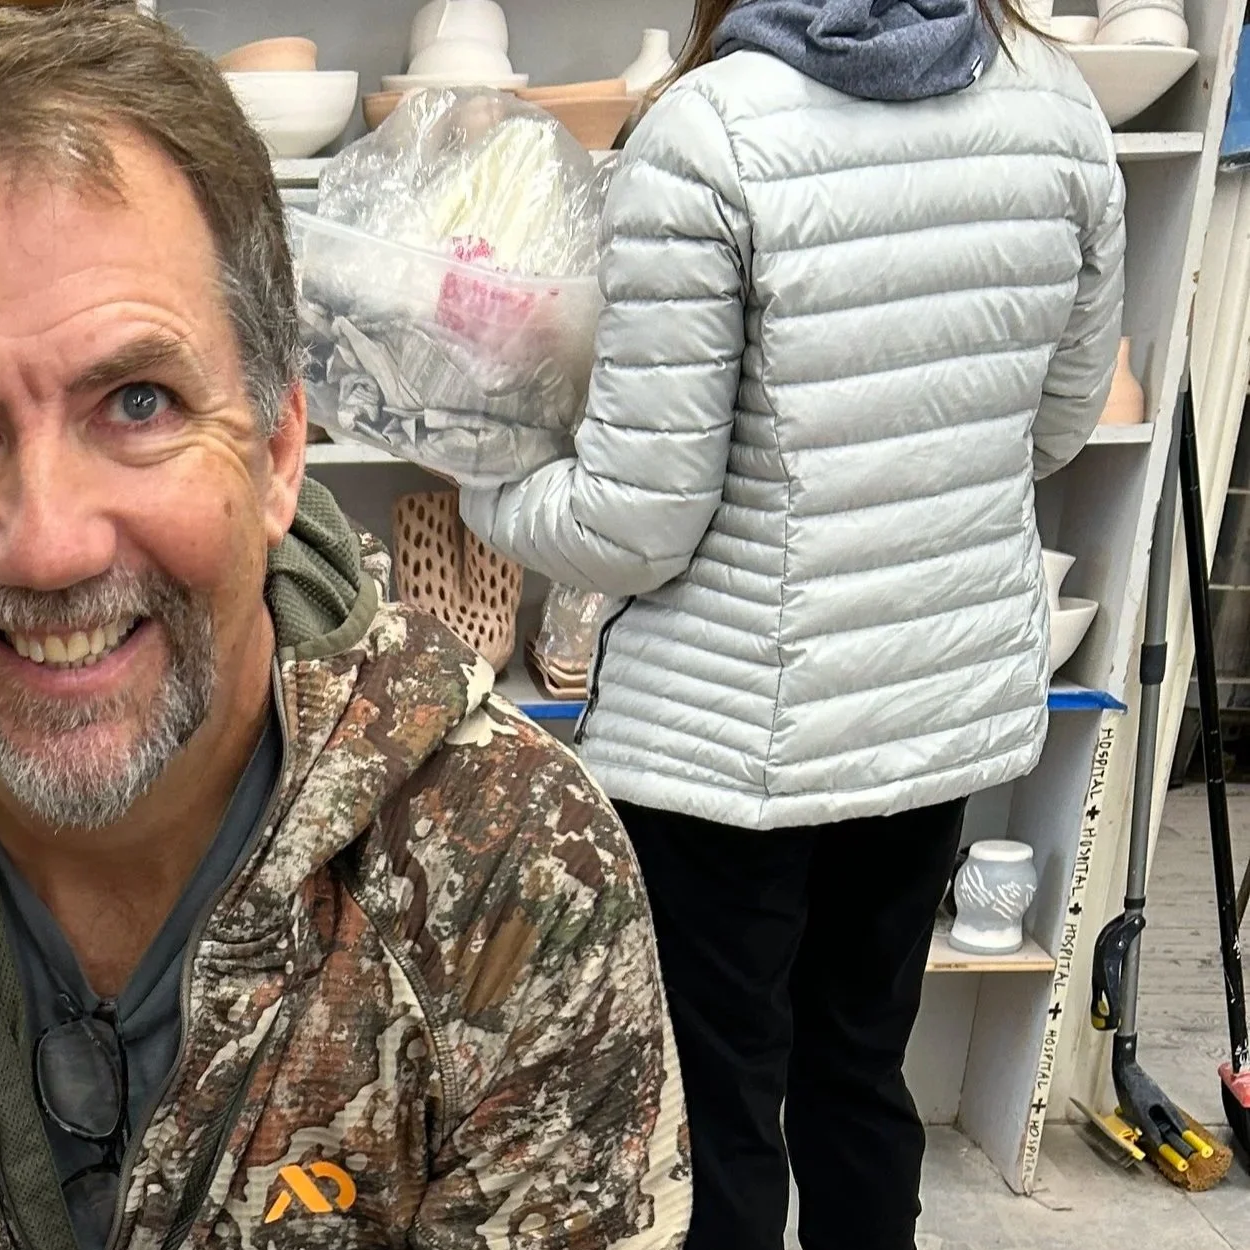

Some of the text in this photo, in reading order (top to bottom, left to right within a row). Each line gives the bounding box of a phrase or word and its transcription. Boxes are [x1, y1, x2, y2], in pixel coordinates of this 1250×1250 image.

[1023, 728, 1114, 1182] HOSPITAL HOSPITAL HOSPITAL HOSPITAL HOSPITAL
